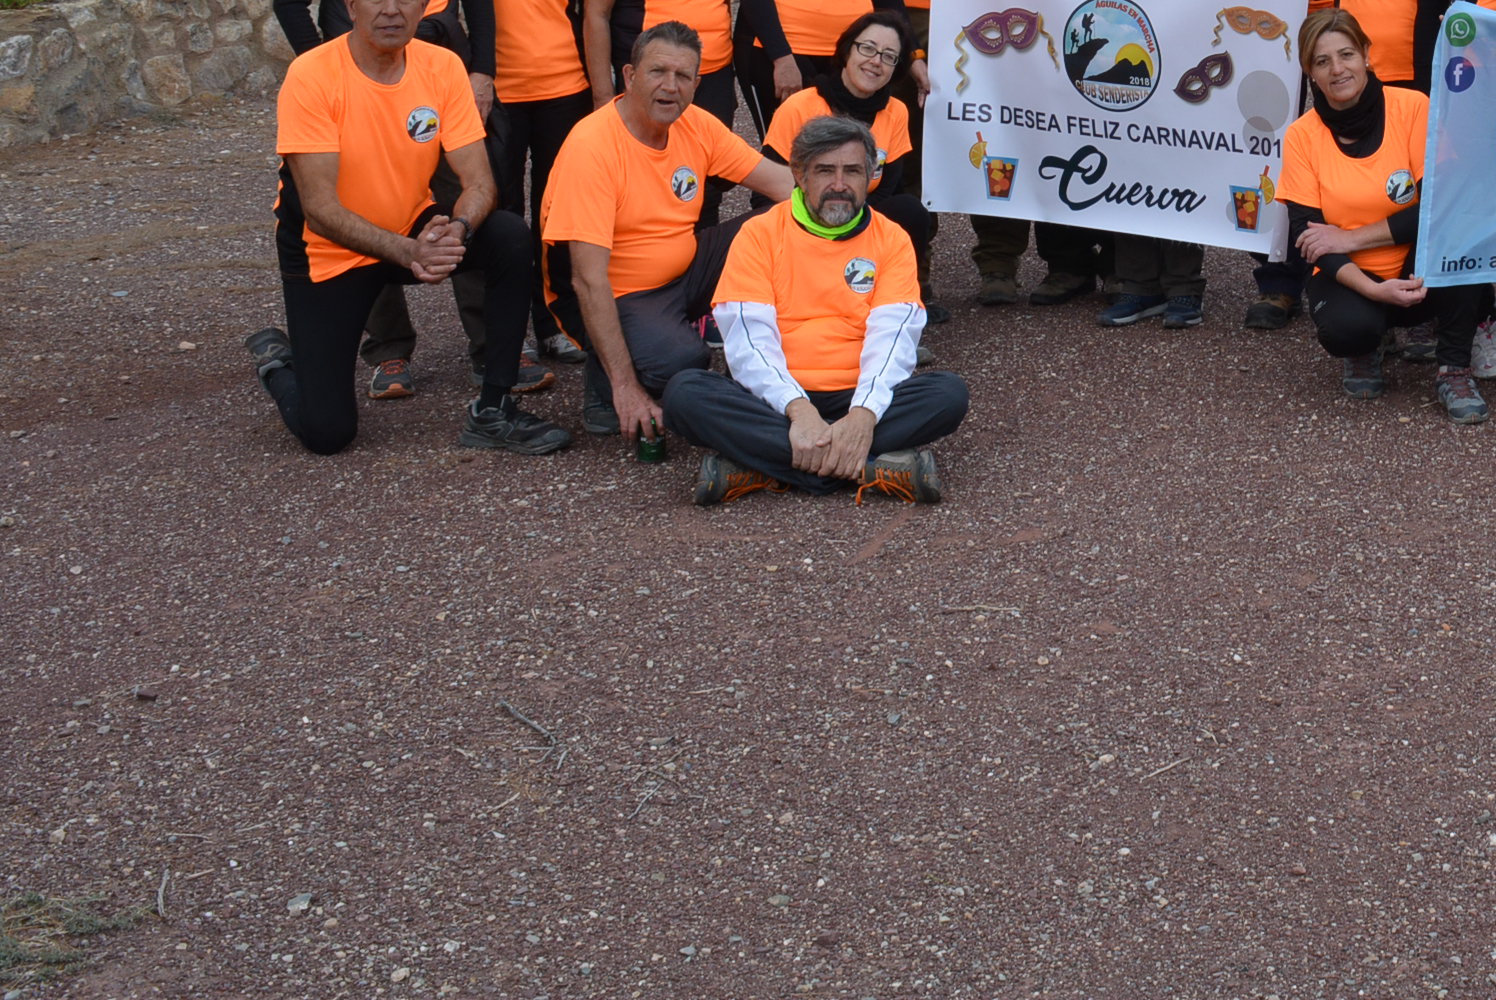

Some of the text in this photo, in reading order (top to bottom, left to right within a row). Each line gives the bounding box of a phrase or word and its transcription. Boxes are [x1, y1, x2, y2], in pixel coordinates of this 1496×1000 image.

[1128, 8, 1138, 19] EN
[1137, 17, 1155, 53] MARCHA
[1075, 80, 1149, 104] CLUB SENDERISTA
[1129, 76, 1150, 86] 2018
[948, 101, 1281, 158] LES DESEA FELIZ CARNAVAL 201
[1038, 145, 1207, 213] Cuerva
[1441, 256, 1482, 272] info:
